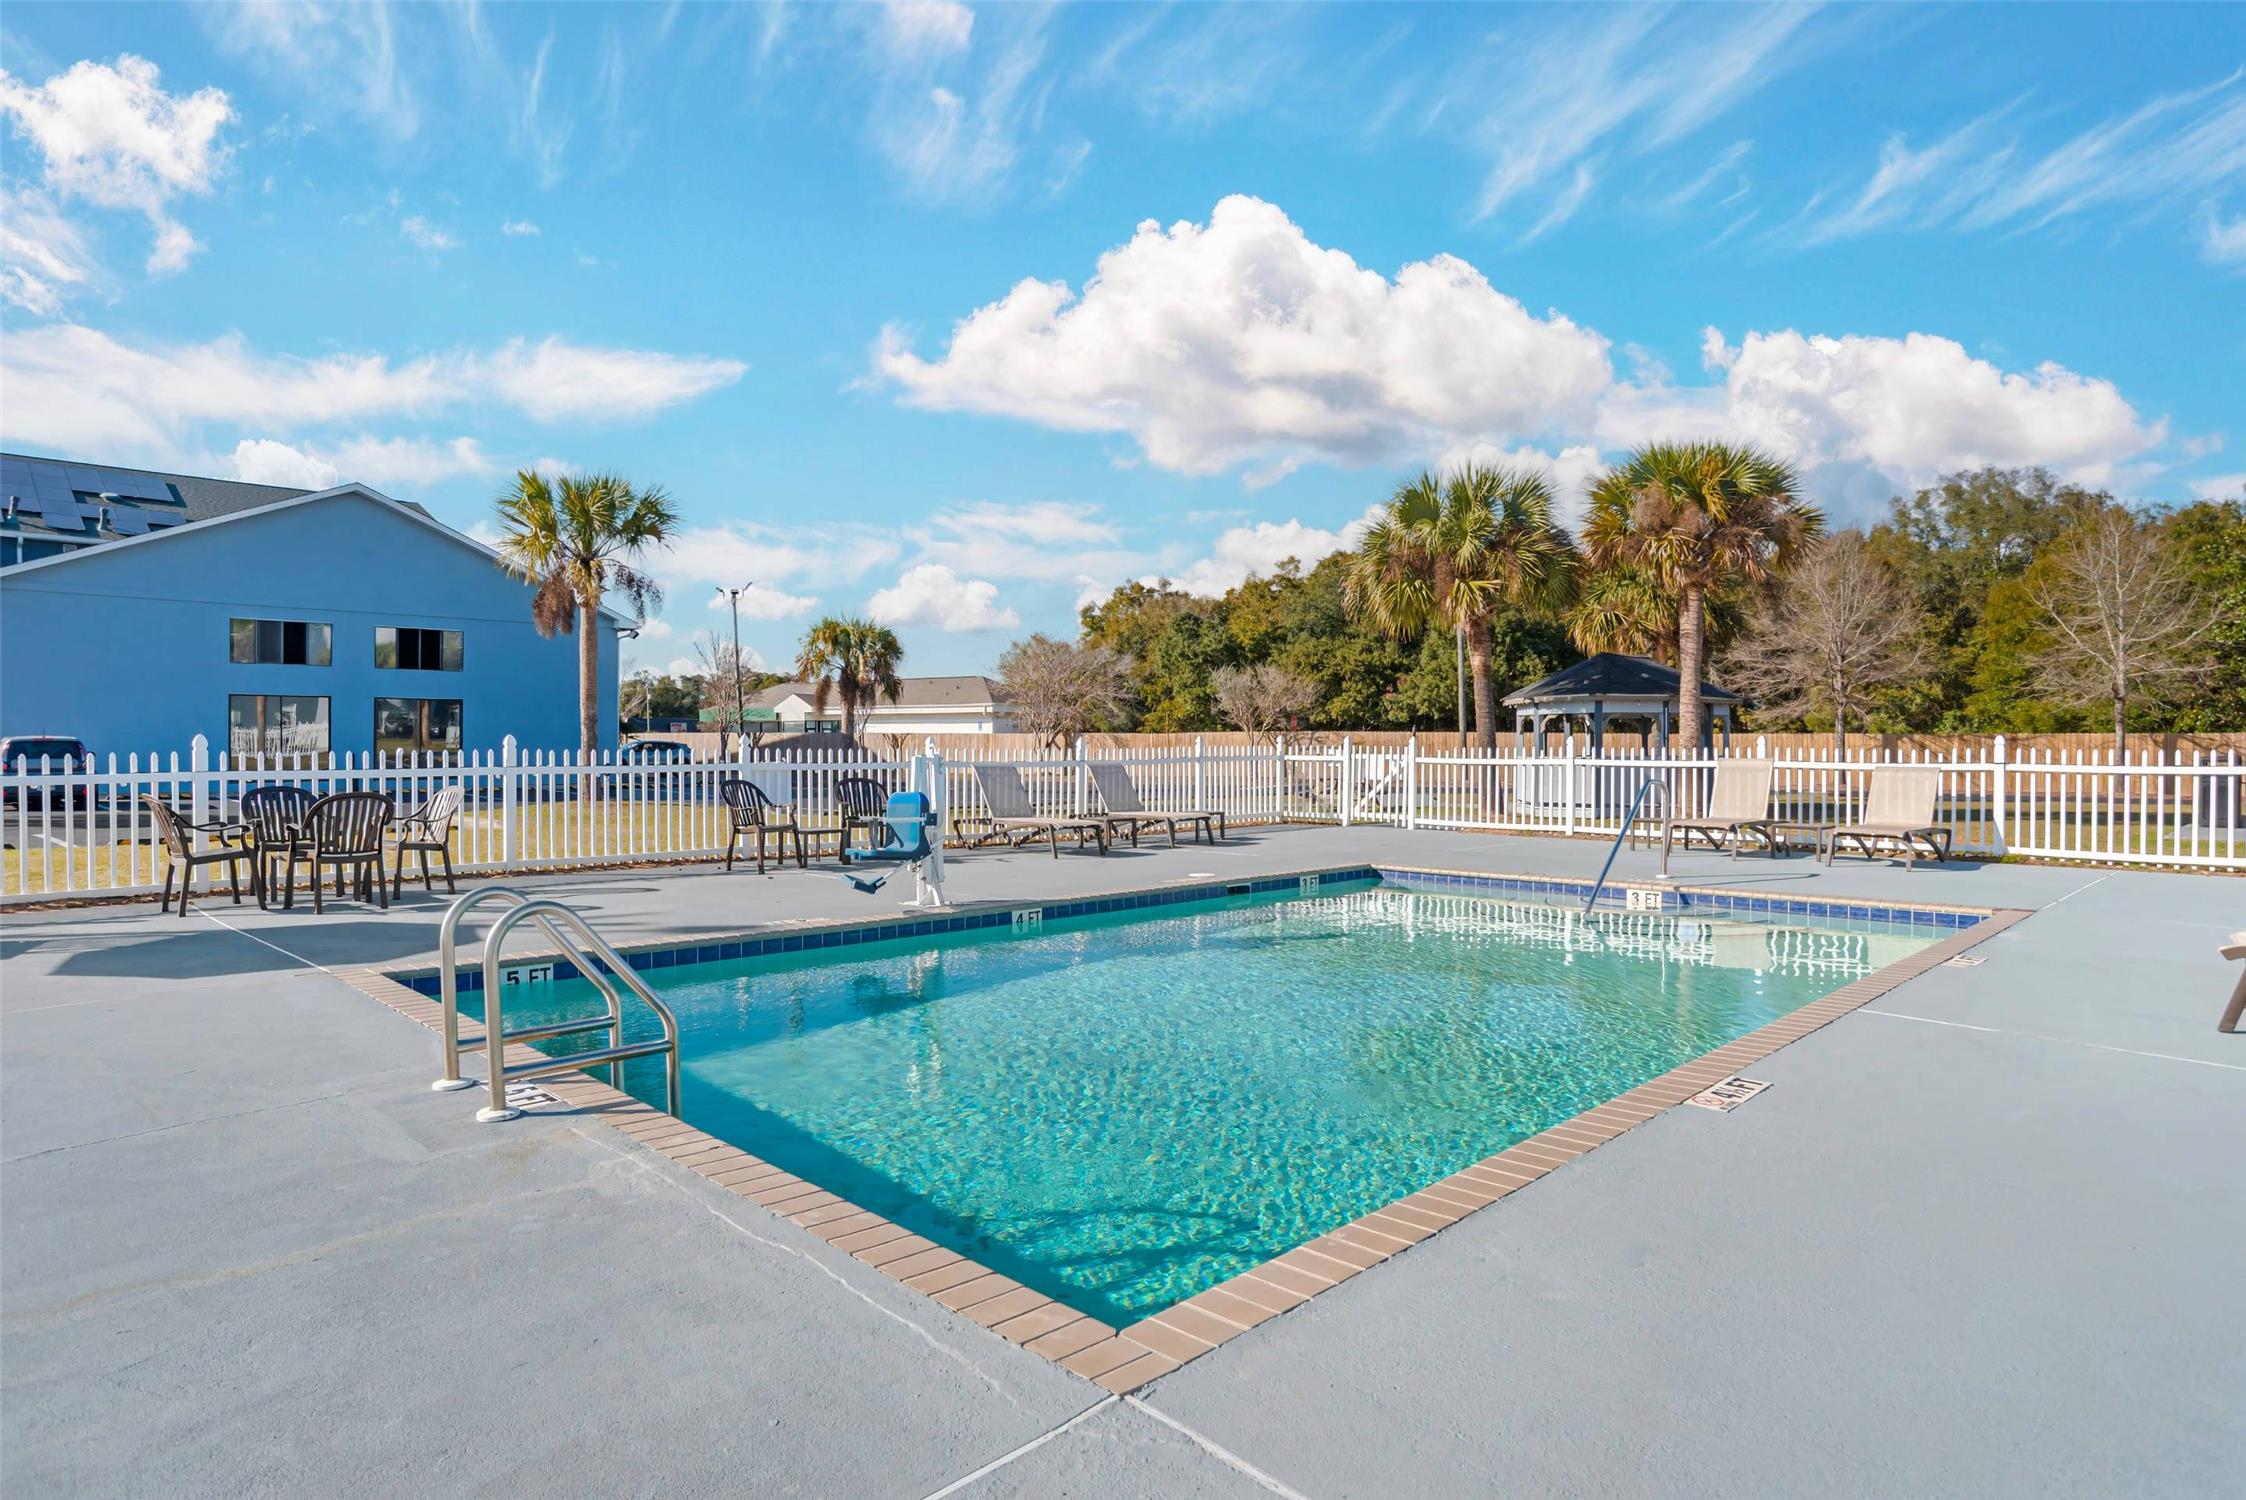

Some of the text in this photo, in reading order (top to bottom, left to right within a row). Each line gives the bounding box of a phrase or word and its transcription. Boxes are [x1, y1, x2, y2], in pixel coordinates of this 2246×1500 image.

[1631, 892, 1660, 904] 3 FT
[1016, 910, 1041, 924] 4 FT
[506, 966, 551, 985] 5 FT
[1724, 1077, 1764, 1091] FT
[508, 1092, 559, 1107] FT
